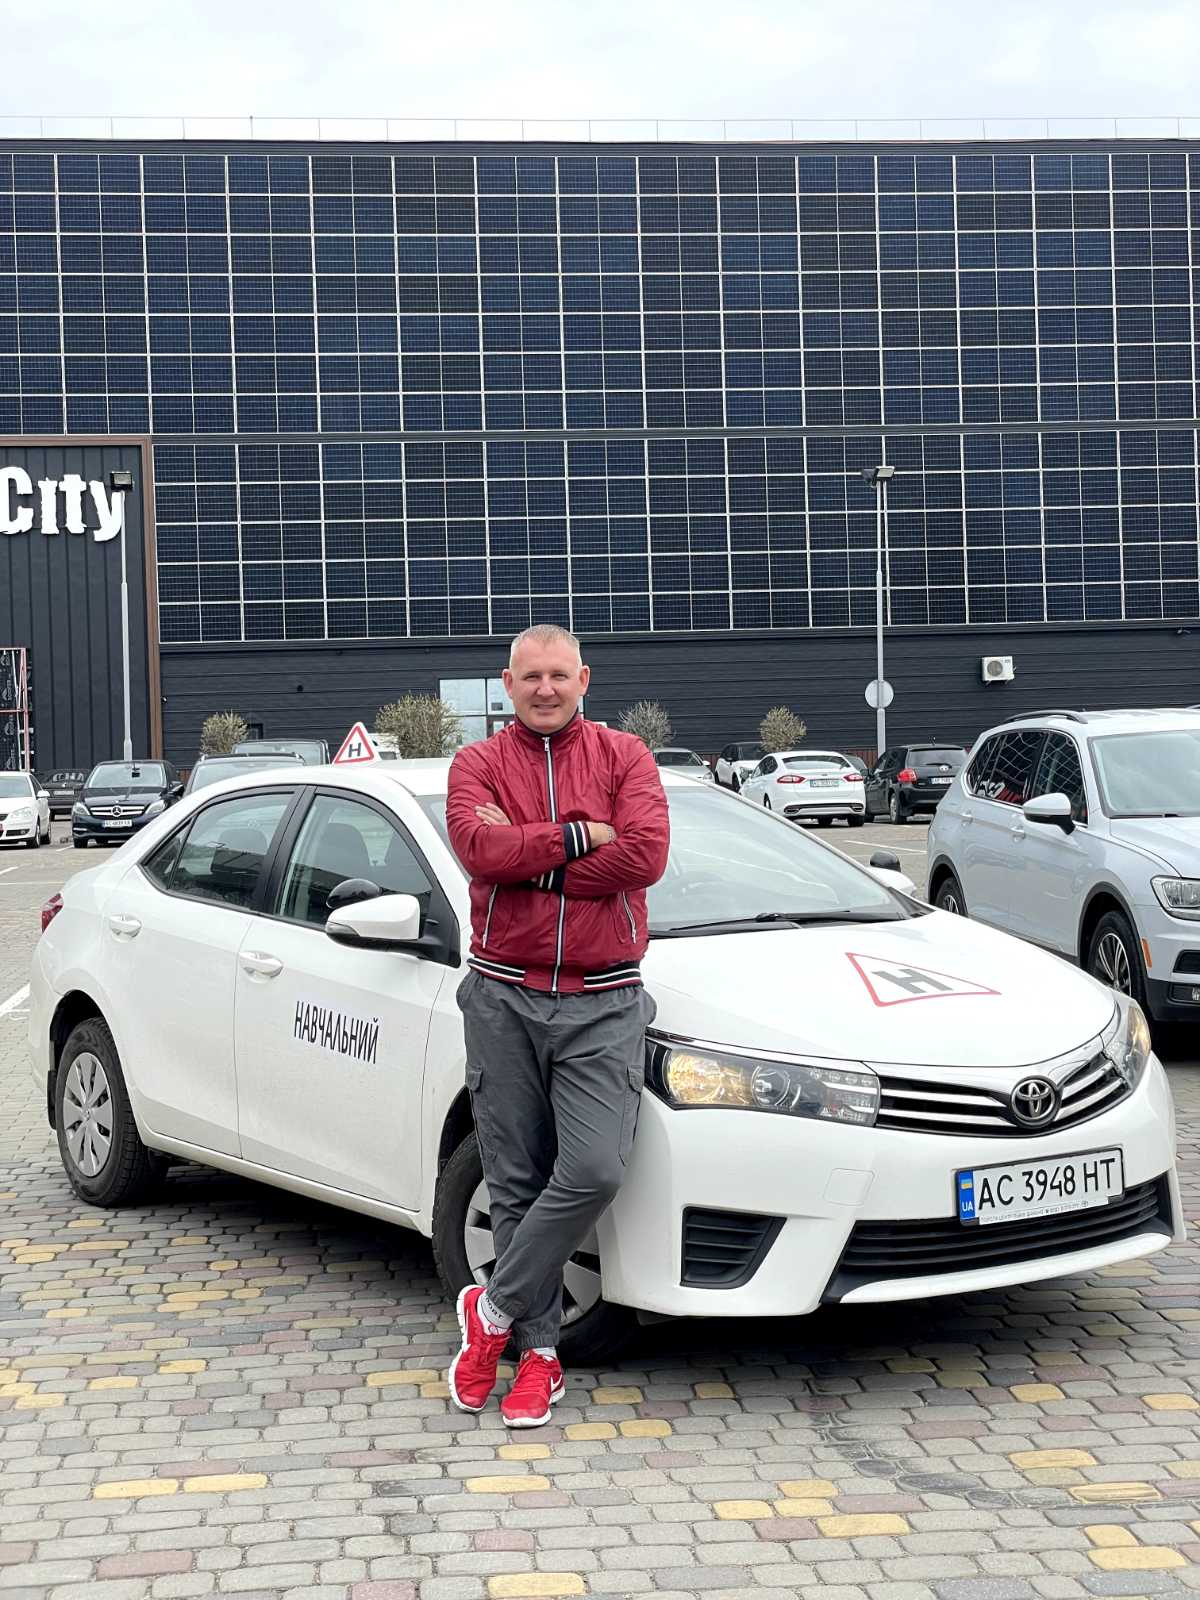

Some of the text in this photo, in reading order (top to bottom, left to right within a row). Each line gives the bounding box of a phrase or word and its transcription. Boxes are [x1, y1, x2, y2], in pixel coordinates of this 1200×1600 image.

[294, 1000, 379, 1064] НАВЧАЛЬНИЙ
[1021, 1164, 1076, 1202] 3948
[961, 1200, 974, 1212] UA
